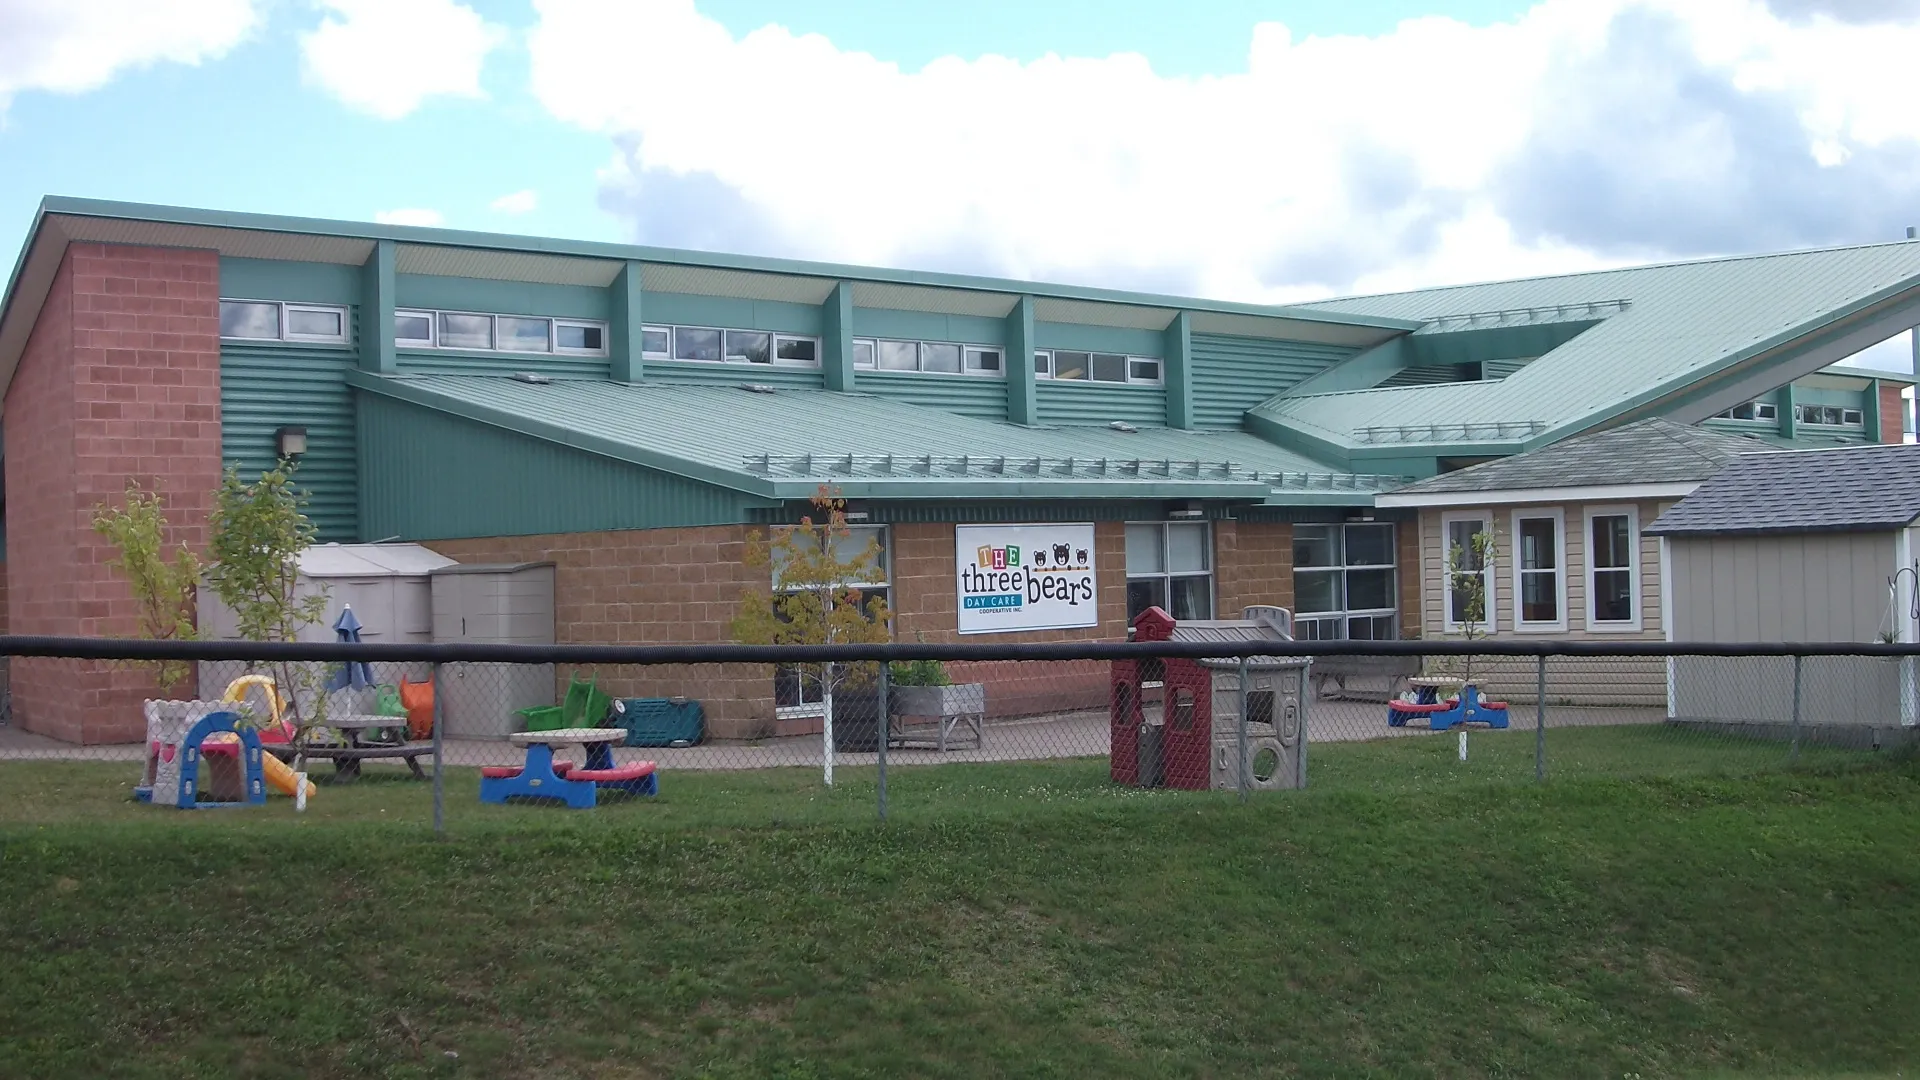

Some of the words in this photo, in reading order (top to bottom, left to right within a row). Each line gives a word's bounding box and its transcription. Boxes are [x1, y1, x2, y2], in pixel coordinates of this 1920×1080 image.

[979, 545, 1018, 568] THE
[961, 563, 1022, 593] three
[1023, 565, 1092, 605] bears
[966, 597, 986, 608] DAY
[991, 595, 1015, 606] CARE
